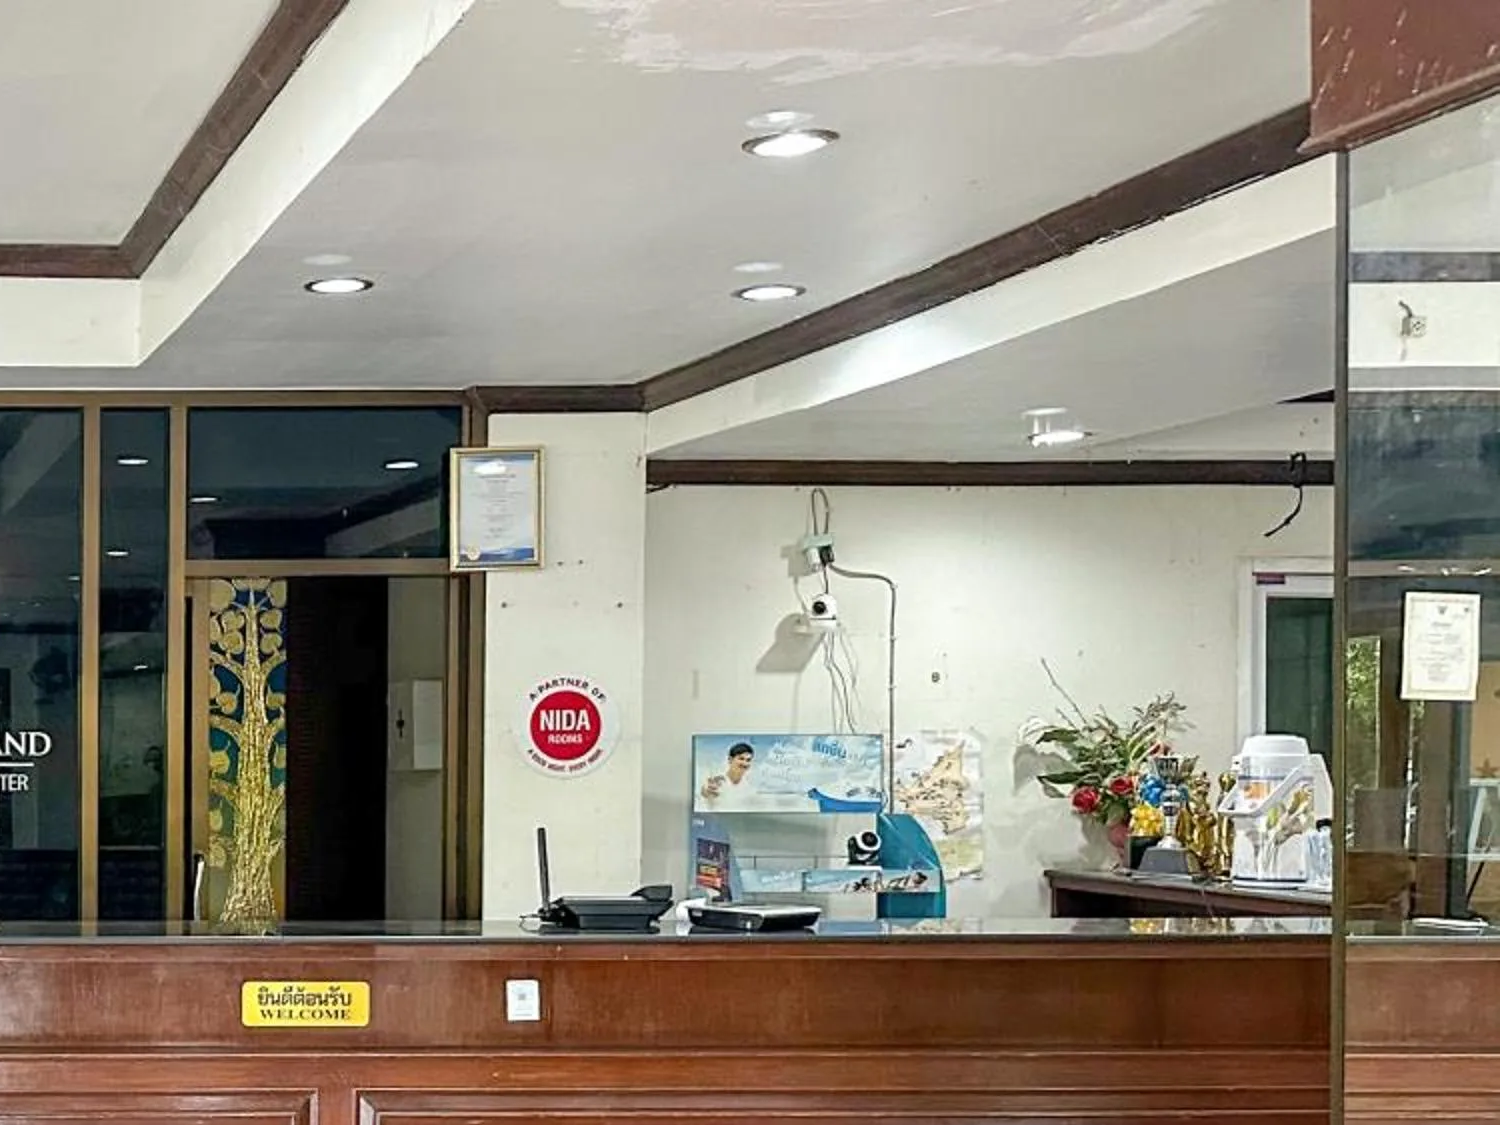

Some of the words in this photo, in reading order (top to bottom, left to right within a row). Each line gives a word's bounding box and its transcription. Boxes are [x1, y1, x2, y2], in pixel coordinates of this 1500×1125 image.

[529, 692, 538, 702] A
[538, 677, 589, 693] PARTNER
[540, 708, 591, 732] NIDA
[547, 732, 584, 745] ROOMS
[256, 985, 353, 1007] ยินดีต้อนรับ
[259, 1008, 352, 1020] WELCOME
